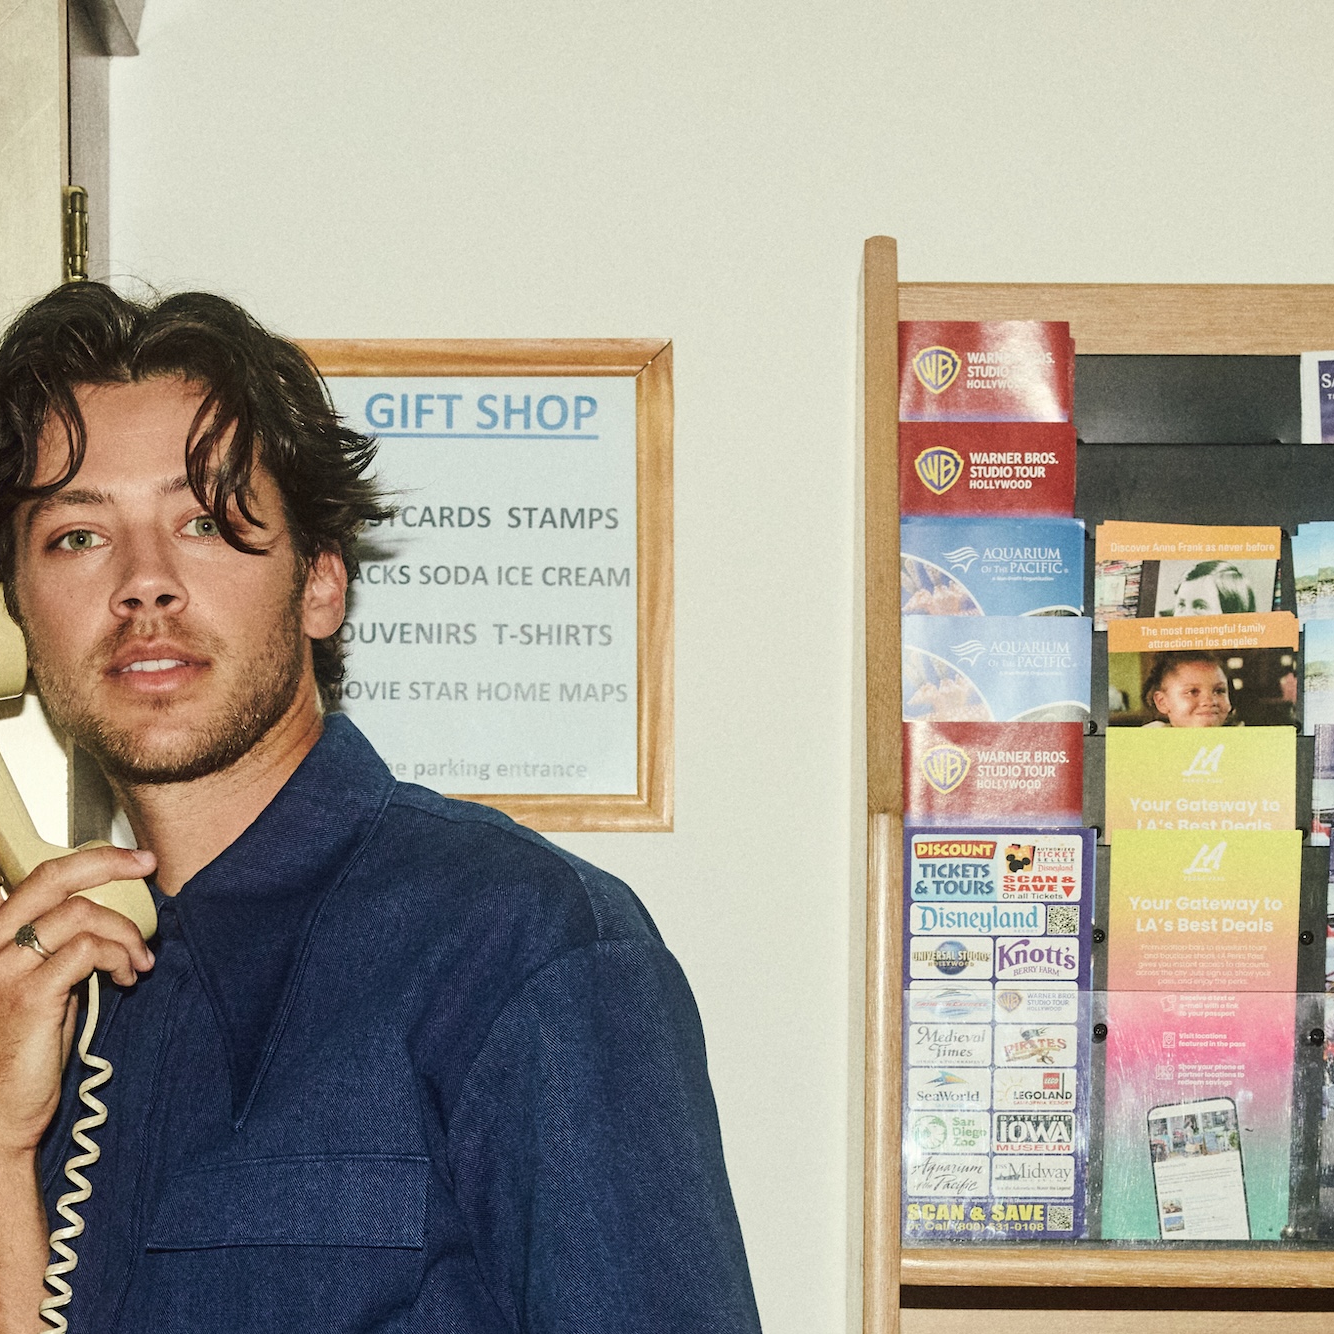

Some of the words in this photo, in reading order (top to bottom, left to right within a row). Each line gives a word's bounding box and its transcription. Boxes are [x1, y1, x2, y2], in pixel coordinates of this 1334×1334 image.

[366, 393, 462, 430] GIFT
[477, 395, 598, 430] SHOP
[970, 453, 1020, 465] WARNER
[1024, 453, 1059, 465] BROS.
[970, 467, 1011, 478] STUDIO
[1014, 467, 1046, 478] TOUR
[969, 480, 1032, 489] HOLLYWOOD
[508, 508, 619, 530] STAMPS
[420, 565, 488, 586] SODA
[497, 567, 533, 586] ICE
[542, 567, 630, 587] CREAM
[340, 622, 477, 645] OUVENIRS
[493, 624, 612, 647] T-SHIRTS
[343, 681, 400, 701] OVIE
[409, 681, 468, 701] STAR
[477, 681, 551, 703] HOME
[559, 682, 628, 703] MAPS
[917, 842, 994, 856] DISCOUNT
[918, 906, 1038, 933] Disneyland
